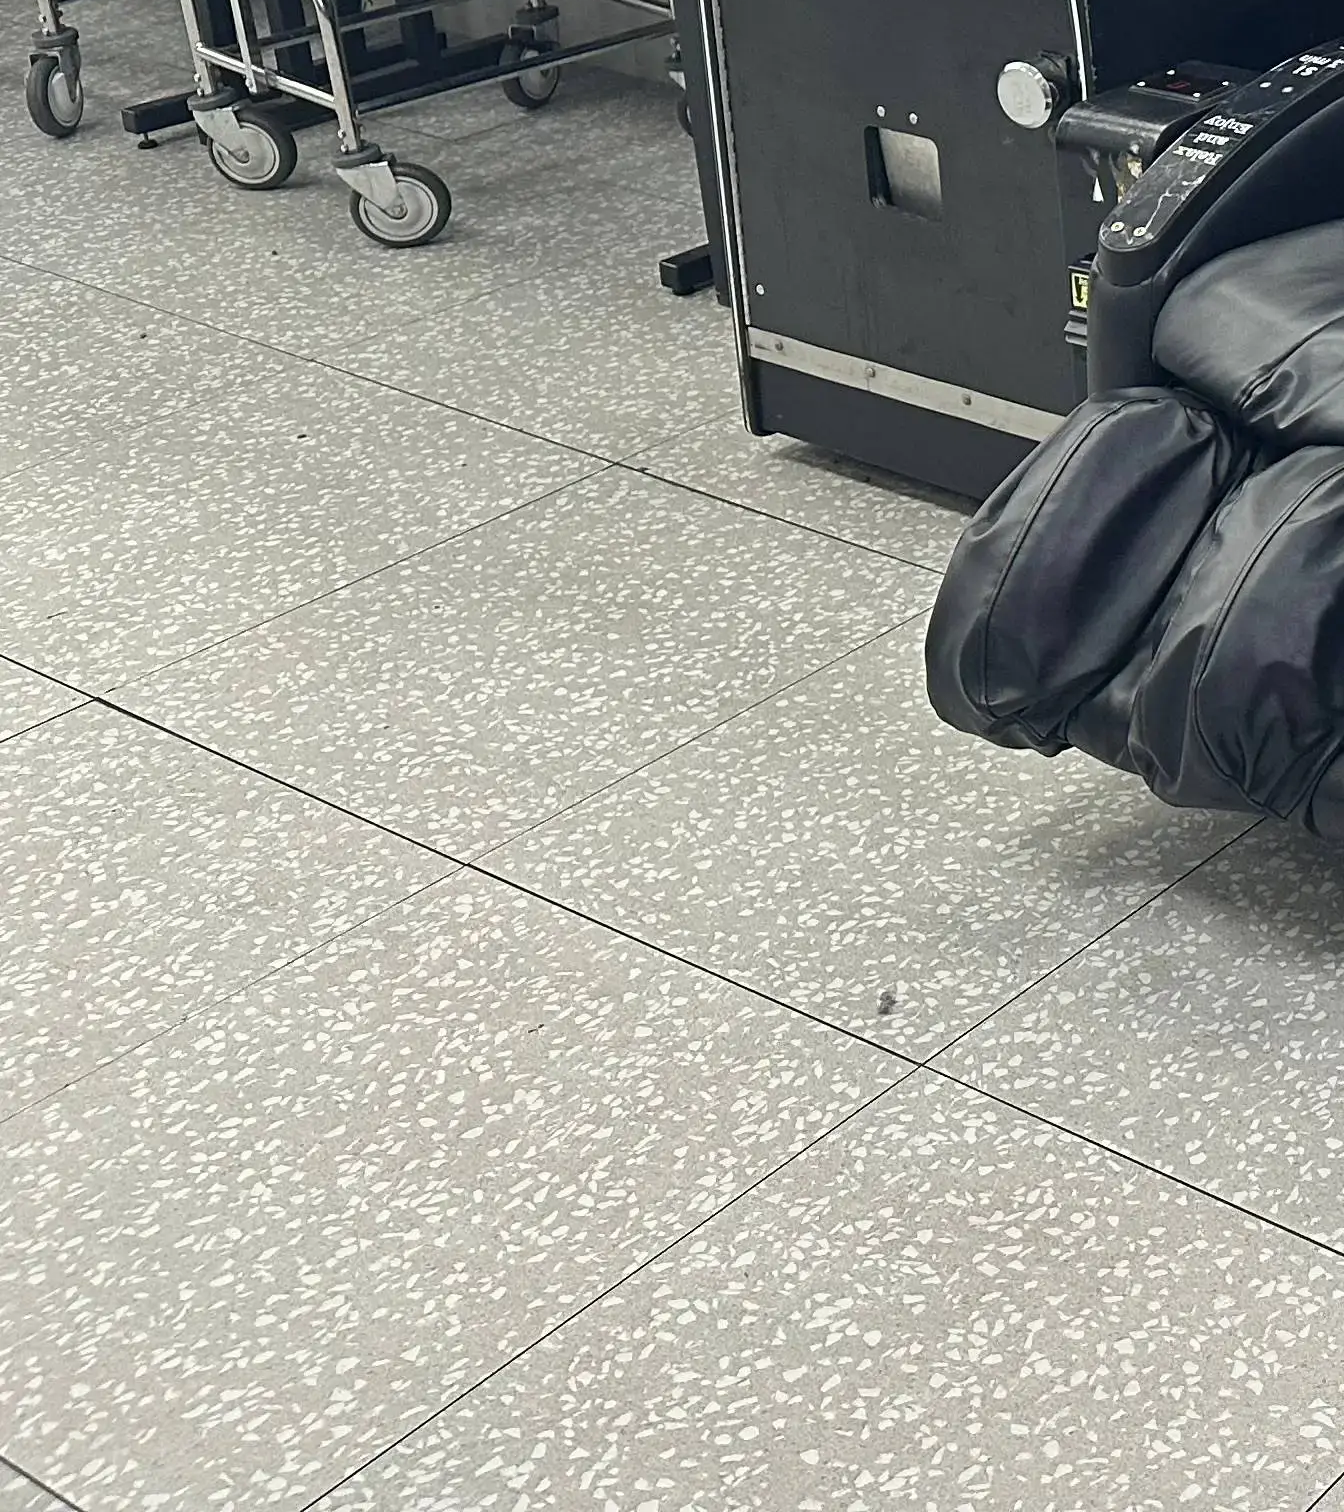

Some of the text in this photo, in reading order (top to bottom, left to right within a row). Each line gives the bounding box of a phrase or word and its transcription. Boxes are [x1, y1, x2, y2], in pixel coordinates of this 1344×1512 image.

[1203, 115, 1254, 135] Enjoy
[1193, 132, 1230, 147] and
[1173, 145, 1223, 166] Relax
